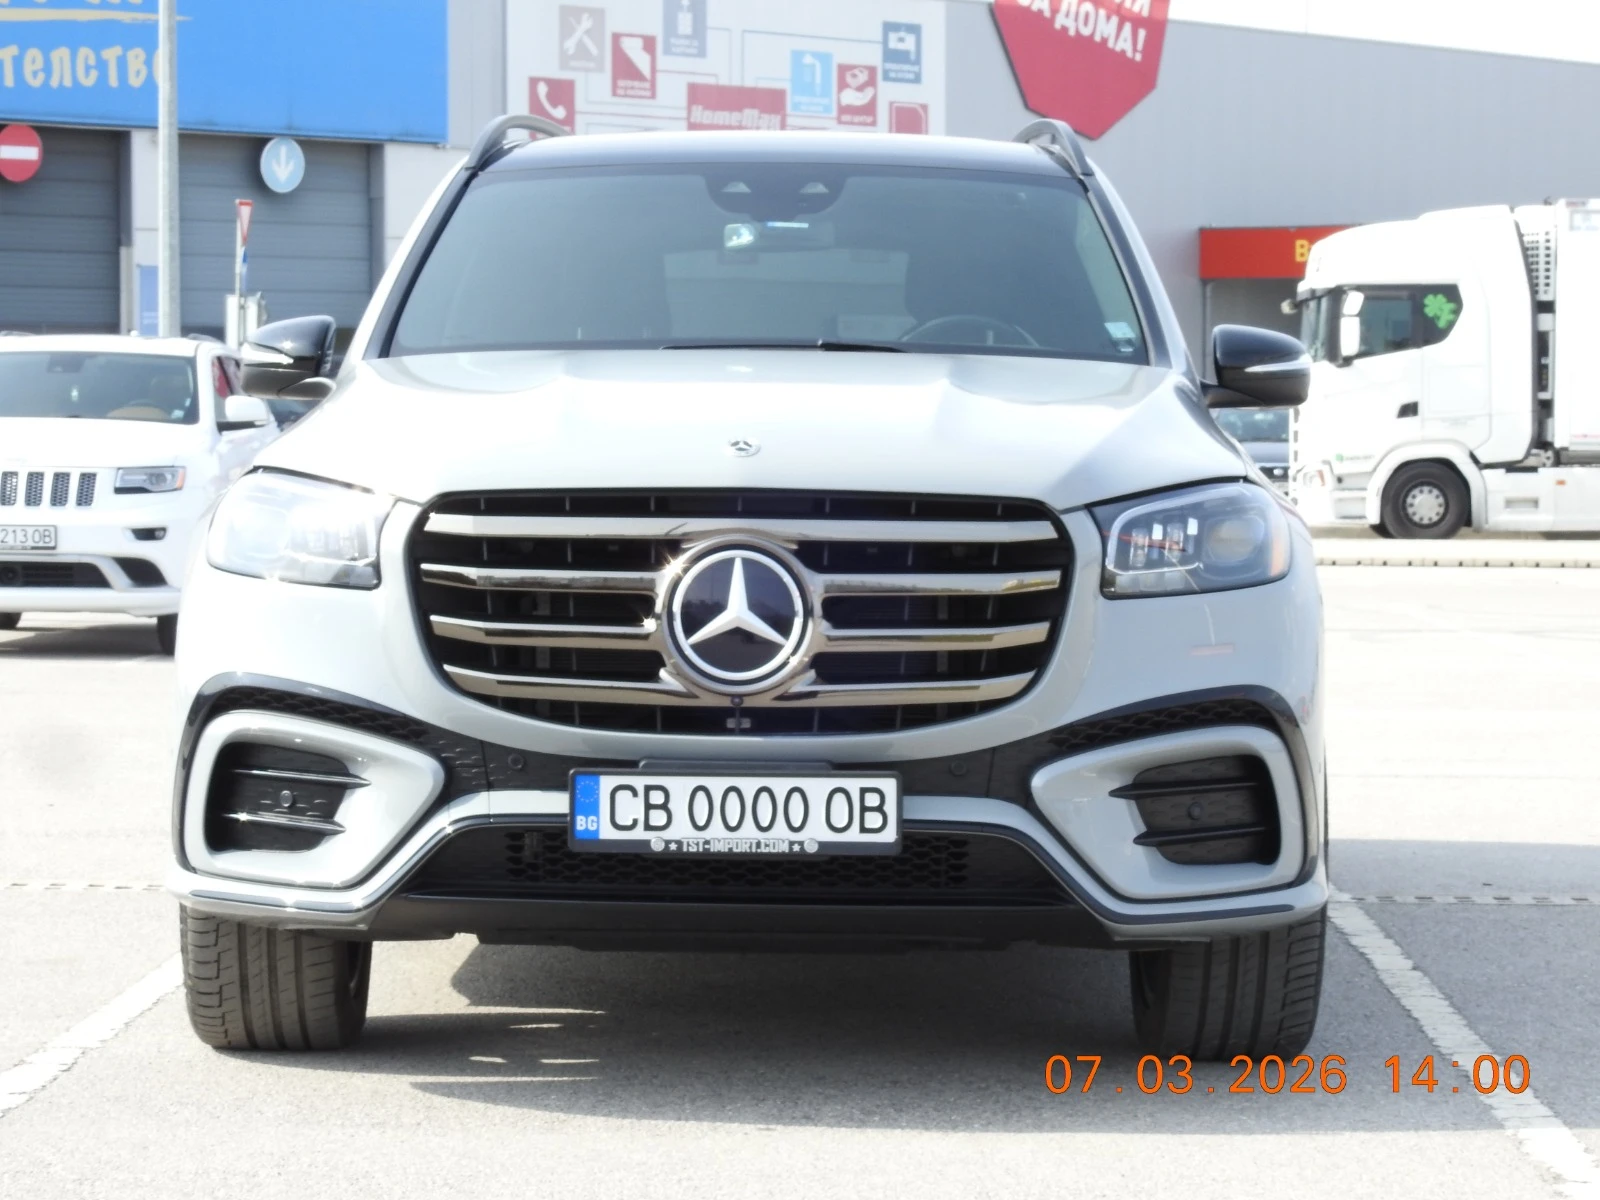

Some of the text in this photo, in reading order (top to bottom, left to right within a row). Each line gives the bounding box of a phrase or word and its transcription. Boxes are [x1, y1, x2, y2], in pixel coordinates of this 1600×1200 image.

[1017, 0, 1051, 18] А
[1054, 0, 1146, 62] ДОМА!
[1295, 240, 1311, 262] В
[0, 529, 28, 544] 213
[609, 784, 888, 834] CB 0000 OB
[576, 816, 598, 831] BG
[681, 838, 790, 853] TST-IMPORT.COM
